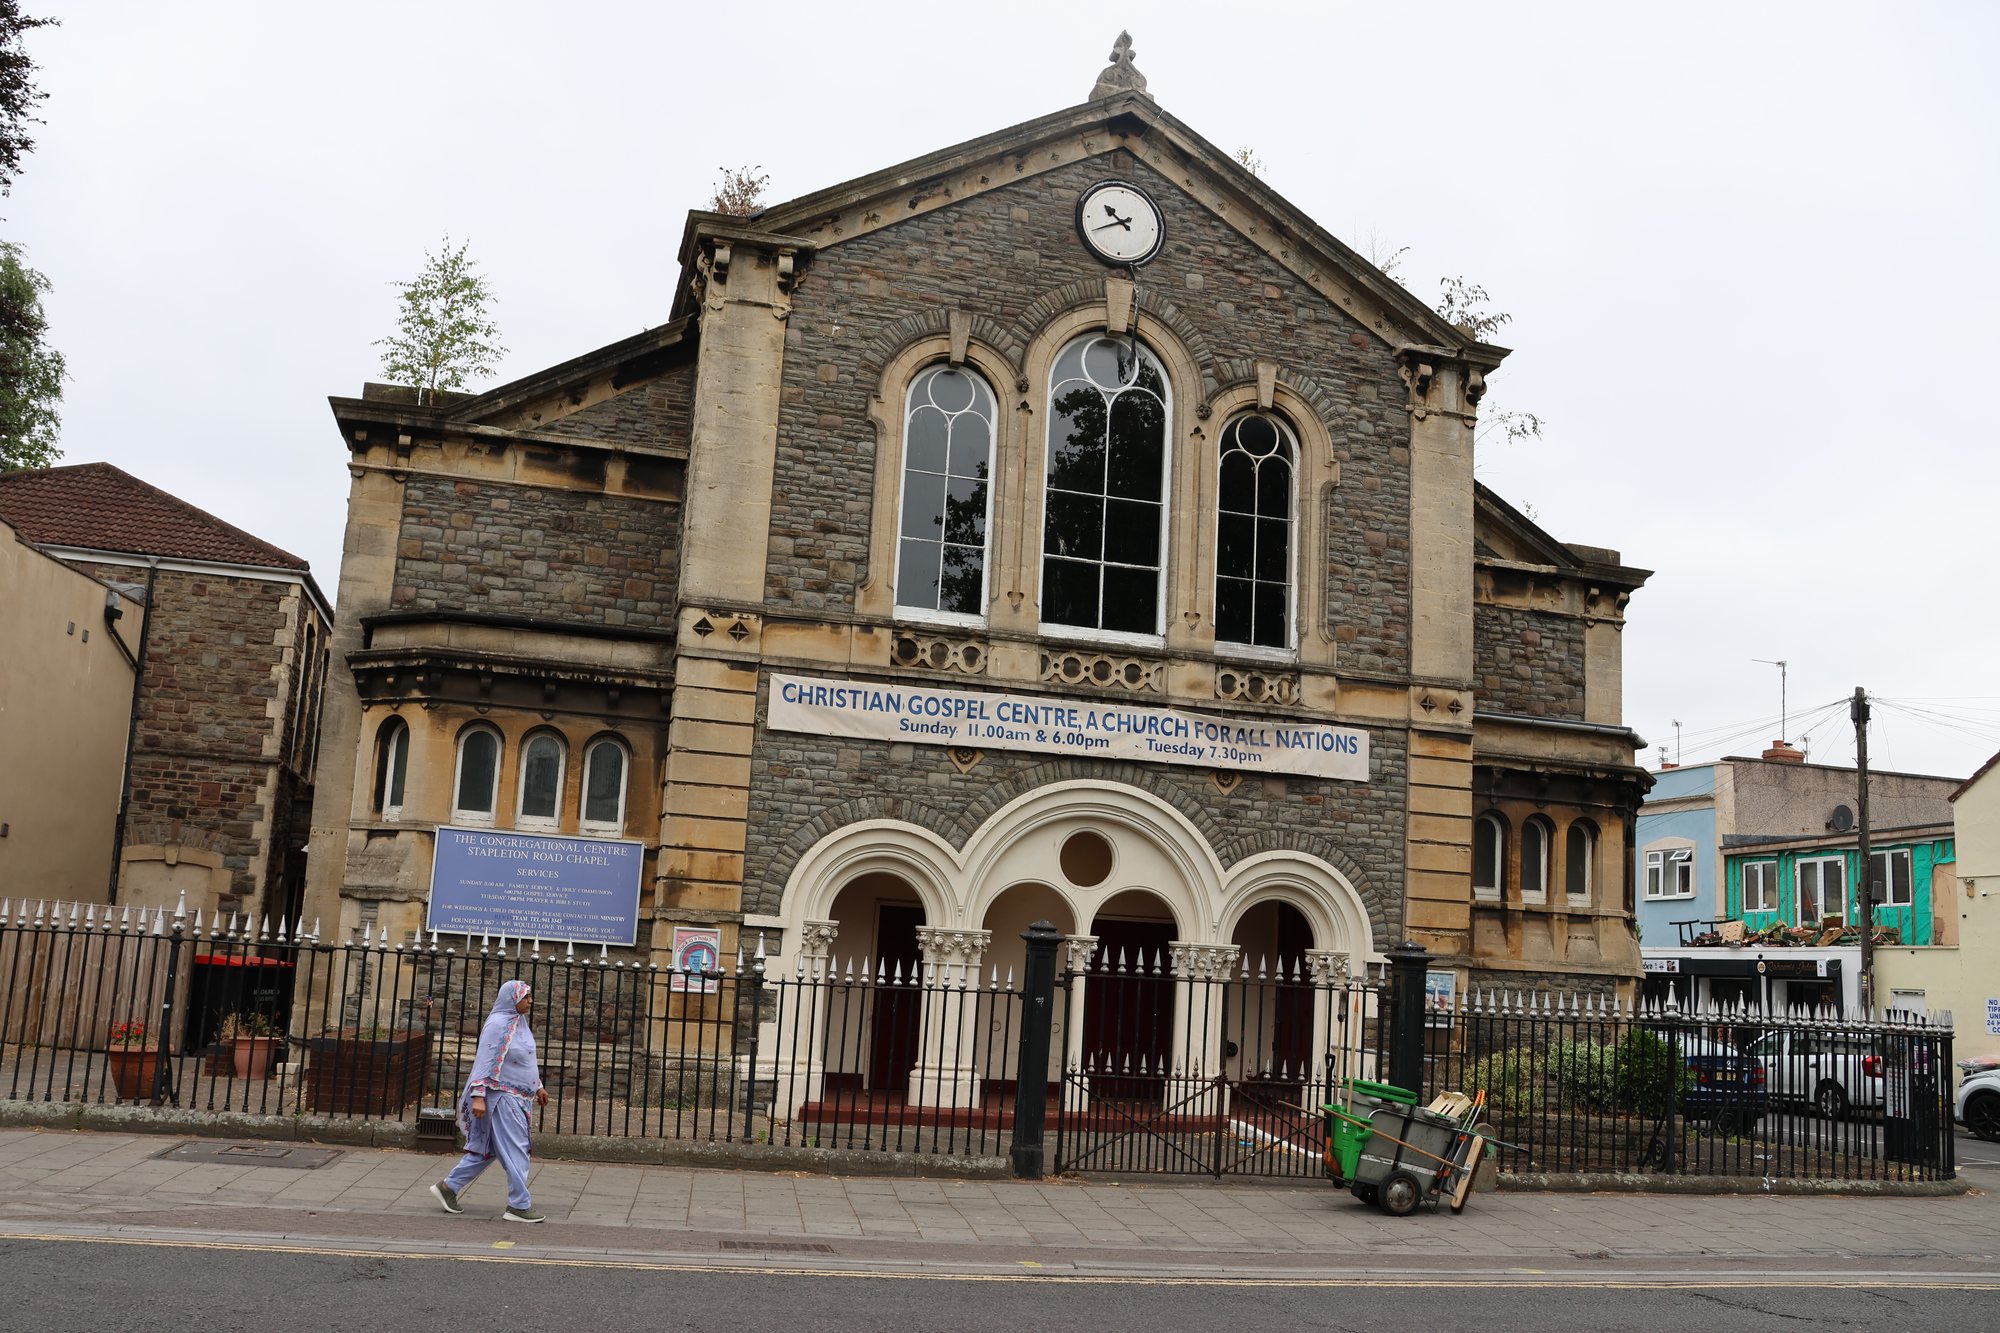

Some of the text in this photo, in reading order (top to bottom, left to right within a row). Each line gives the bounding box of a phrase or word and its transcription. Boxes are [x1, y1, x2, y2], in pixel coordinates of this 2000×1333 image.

[782, 683, 1358, 754] CHRISTIAN GOSPEL CENTRE, A CHURCH FOR ALL NATIONS
[899, 718, 1262, 764] Sunday 11.00am & 6.00pm Tuesday 7.30pm
[454, 834, 628, 856] THE CONGREGATIONAL CENTRE
[467, 847, 610, 866] STAPLETON ROAD CHAPEL
[517, 868, 560, 879] SERVICES
[451, 917, 482, 925] FOUNDED
[566, 925, 598, 933] WELCOME
